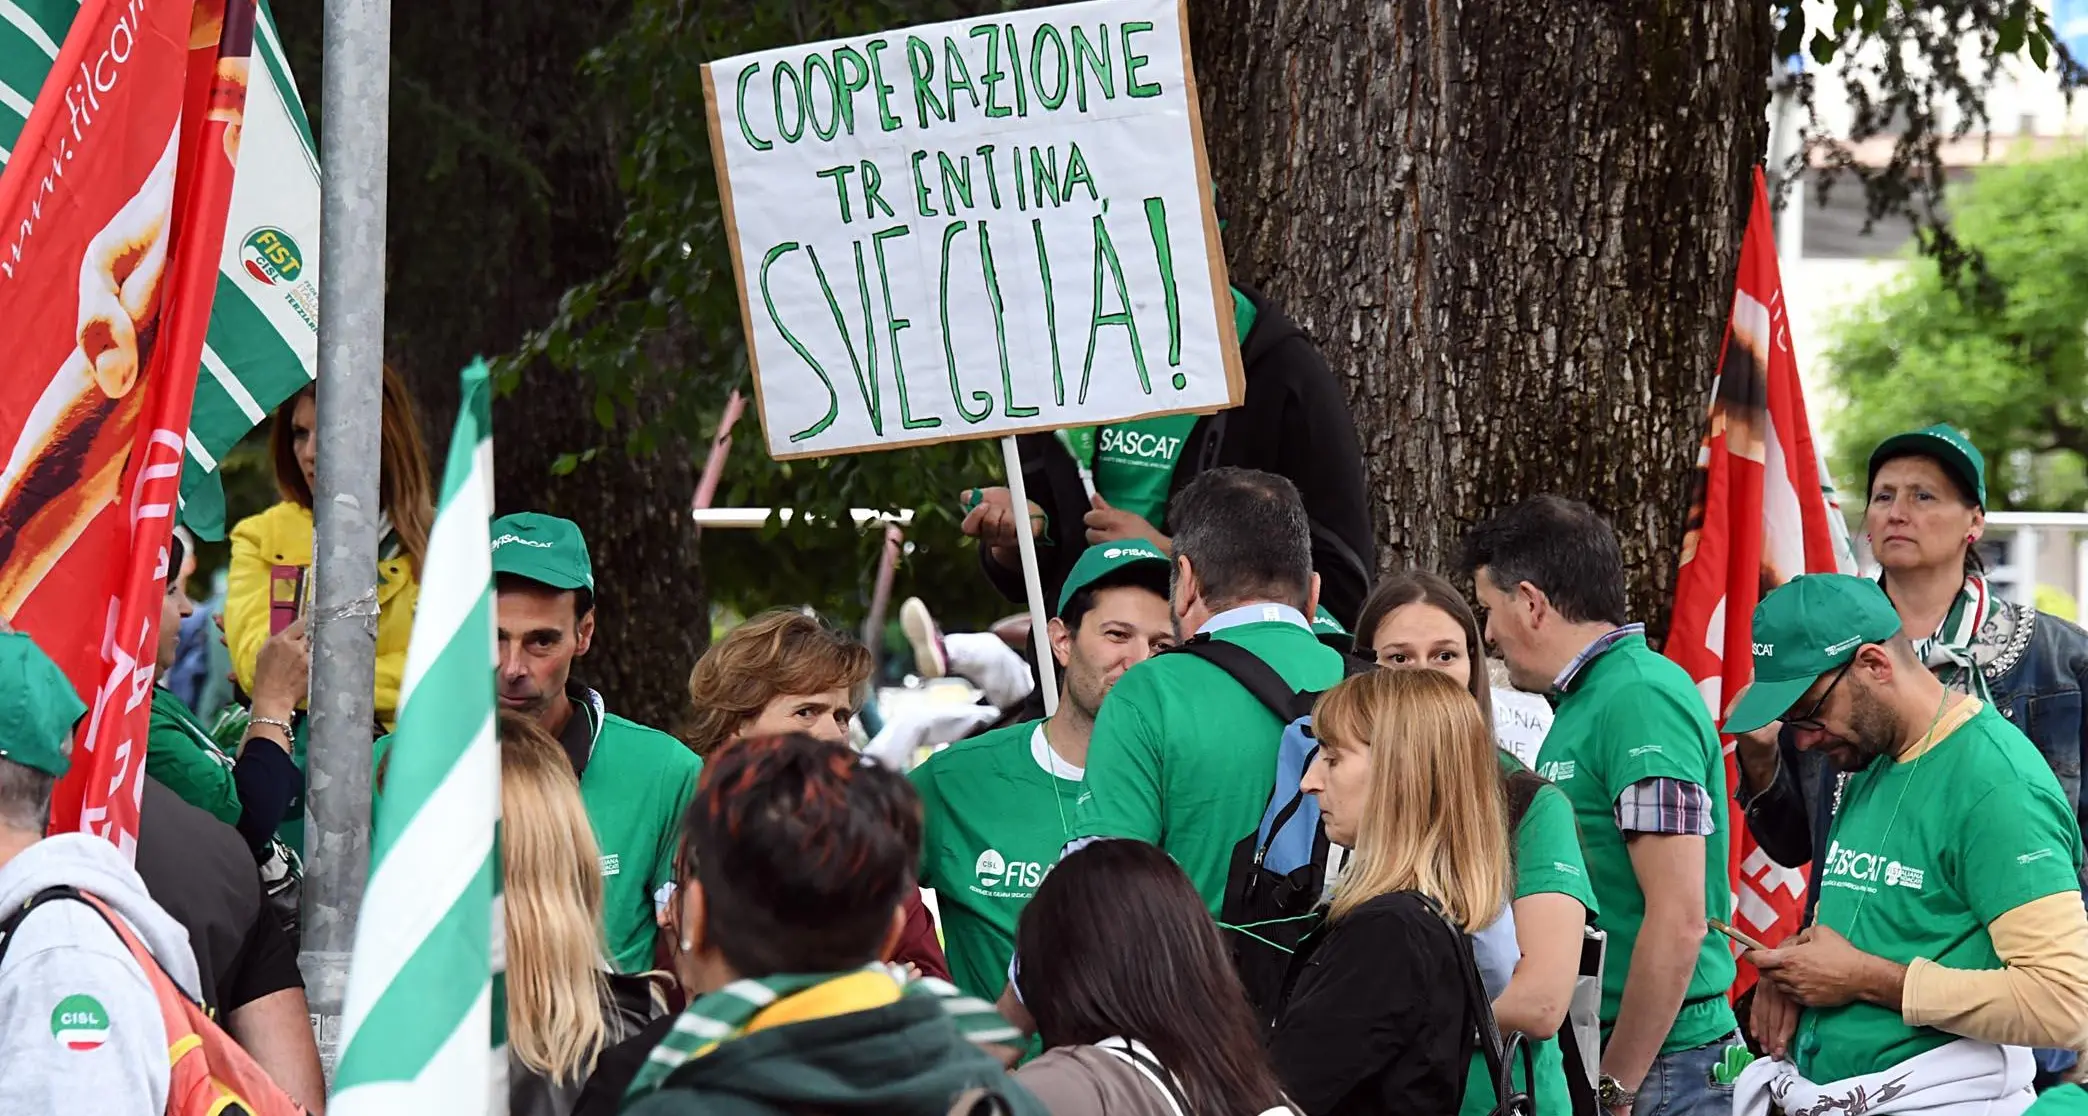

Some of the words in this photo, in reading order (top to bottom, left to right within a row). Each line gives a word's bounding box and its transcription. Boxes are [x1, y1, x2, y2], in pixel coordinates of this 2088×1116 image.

[736, 21, 1162, 150] COOPERAZIONE
[255, 231, 300, 273] FIST
[255, 256, 280, 283] CISL
[759, 197, 1187, 442] SVEGLIA!
[1099, 428, 1180, 460] SASCAT
[60, 1011, 100, 1025] CISL
